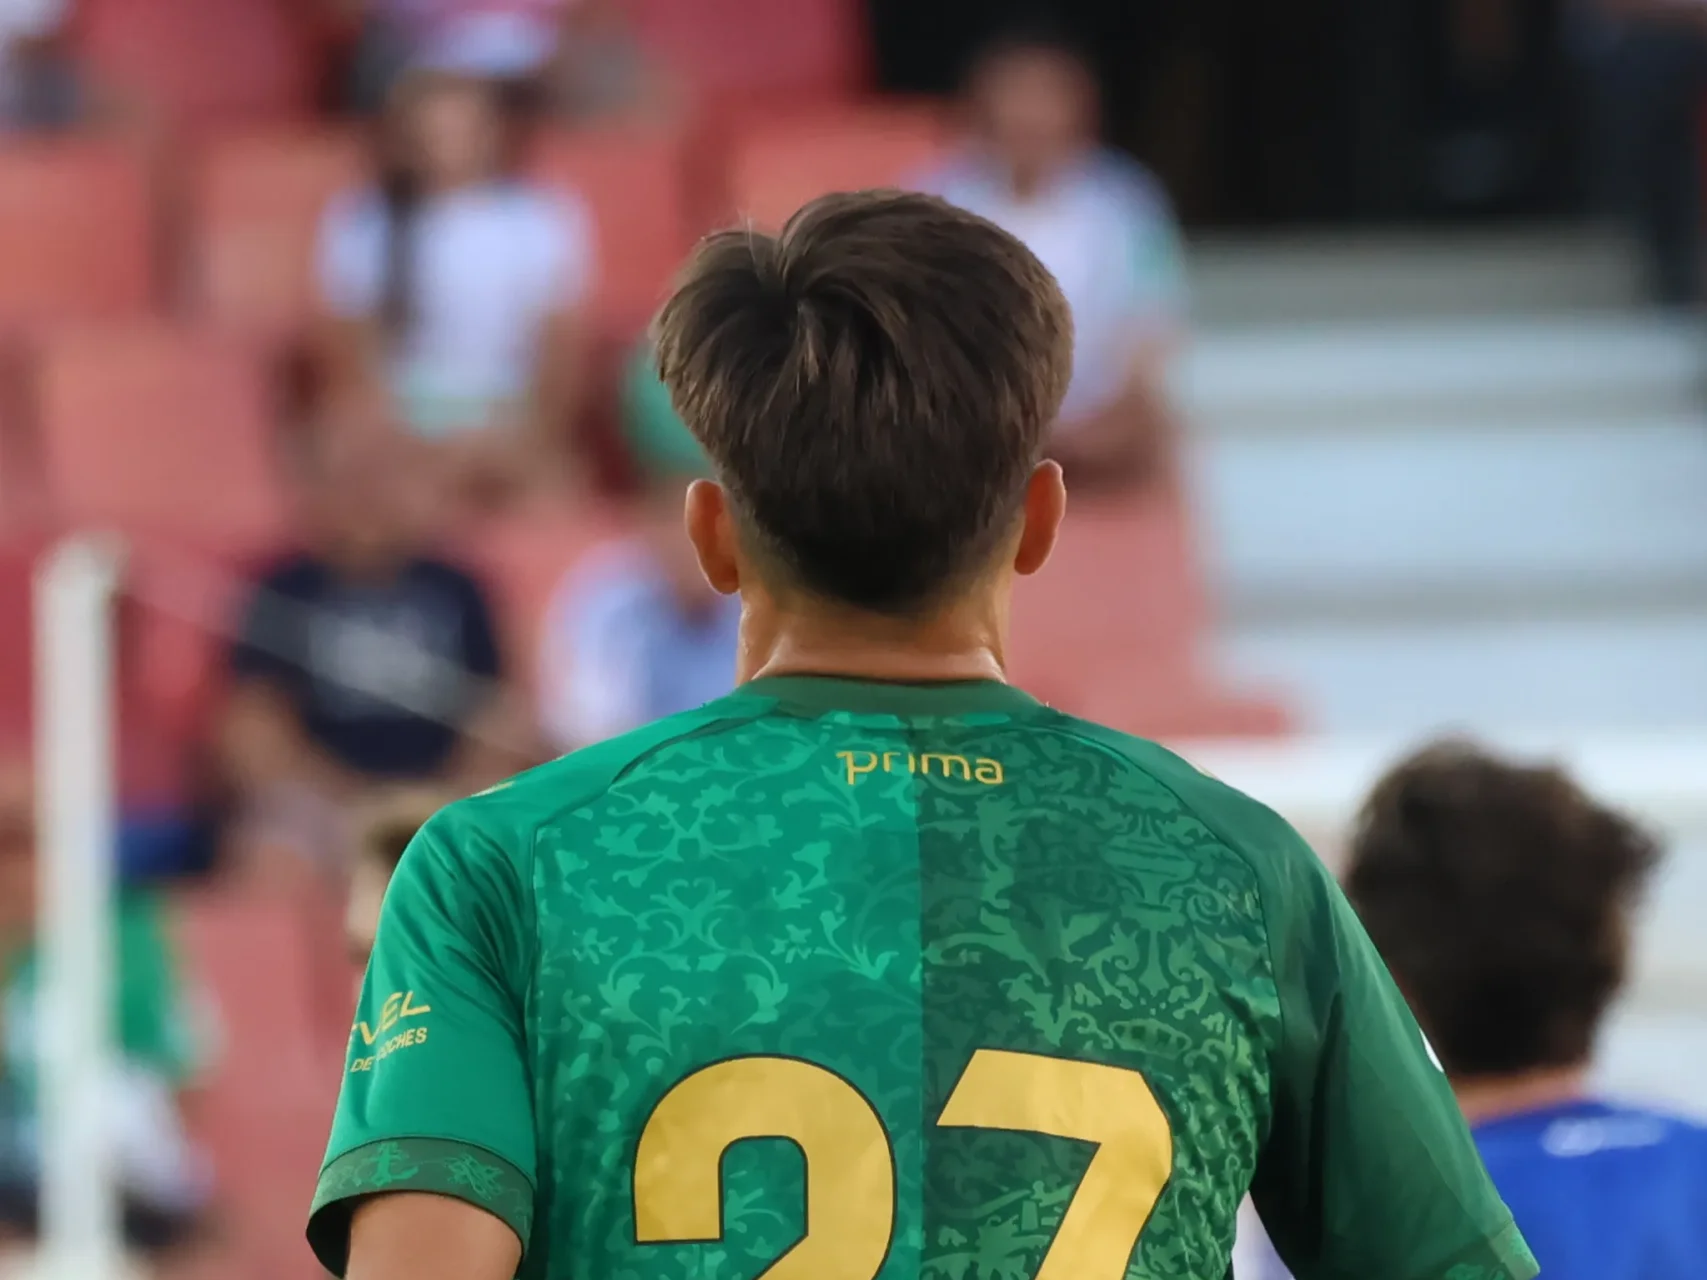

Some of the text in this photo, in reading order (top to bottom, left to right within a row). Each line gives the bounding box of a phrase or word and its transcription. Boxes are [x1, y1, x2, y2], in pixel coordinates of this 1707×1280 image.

[836, 750, 1004, 785] prima
[351, 990, 431, 1045] VEL
[350, 1056, 375, 1073] DE
